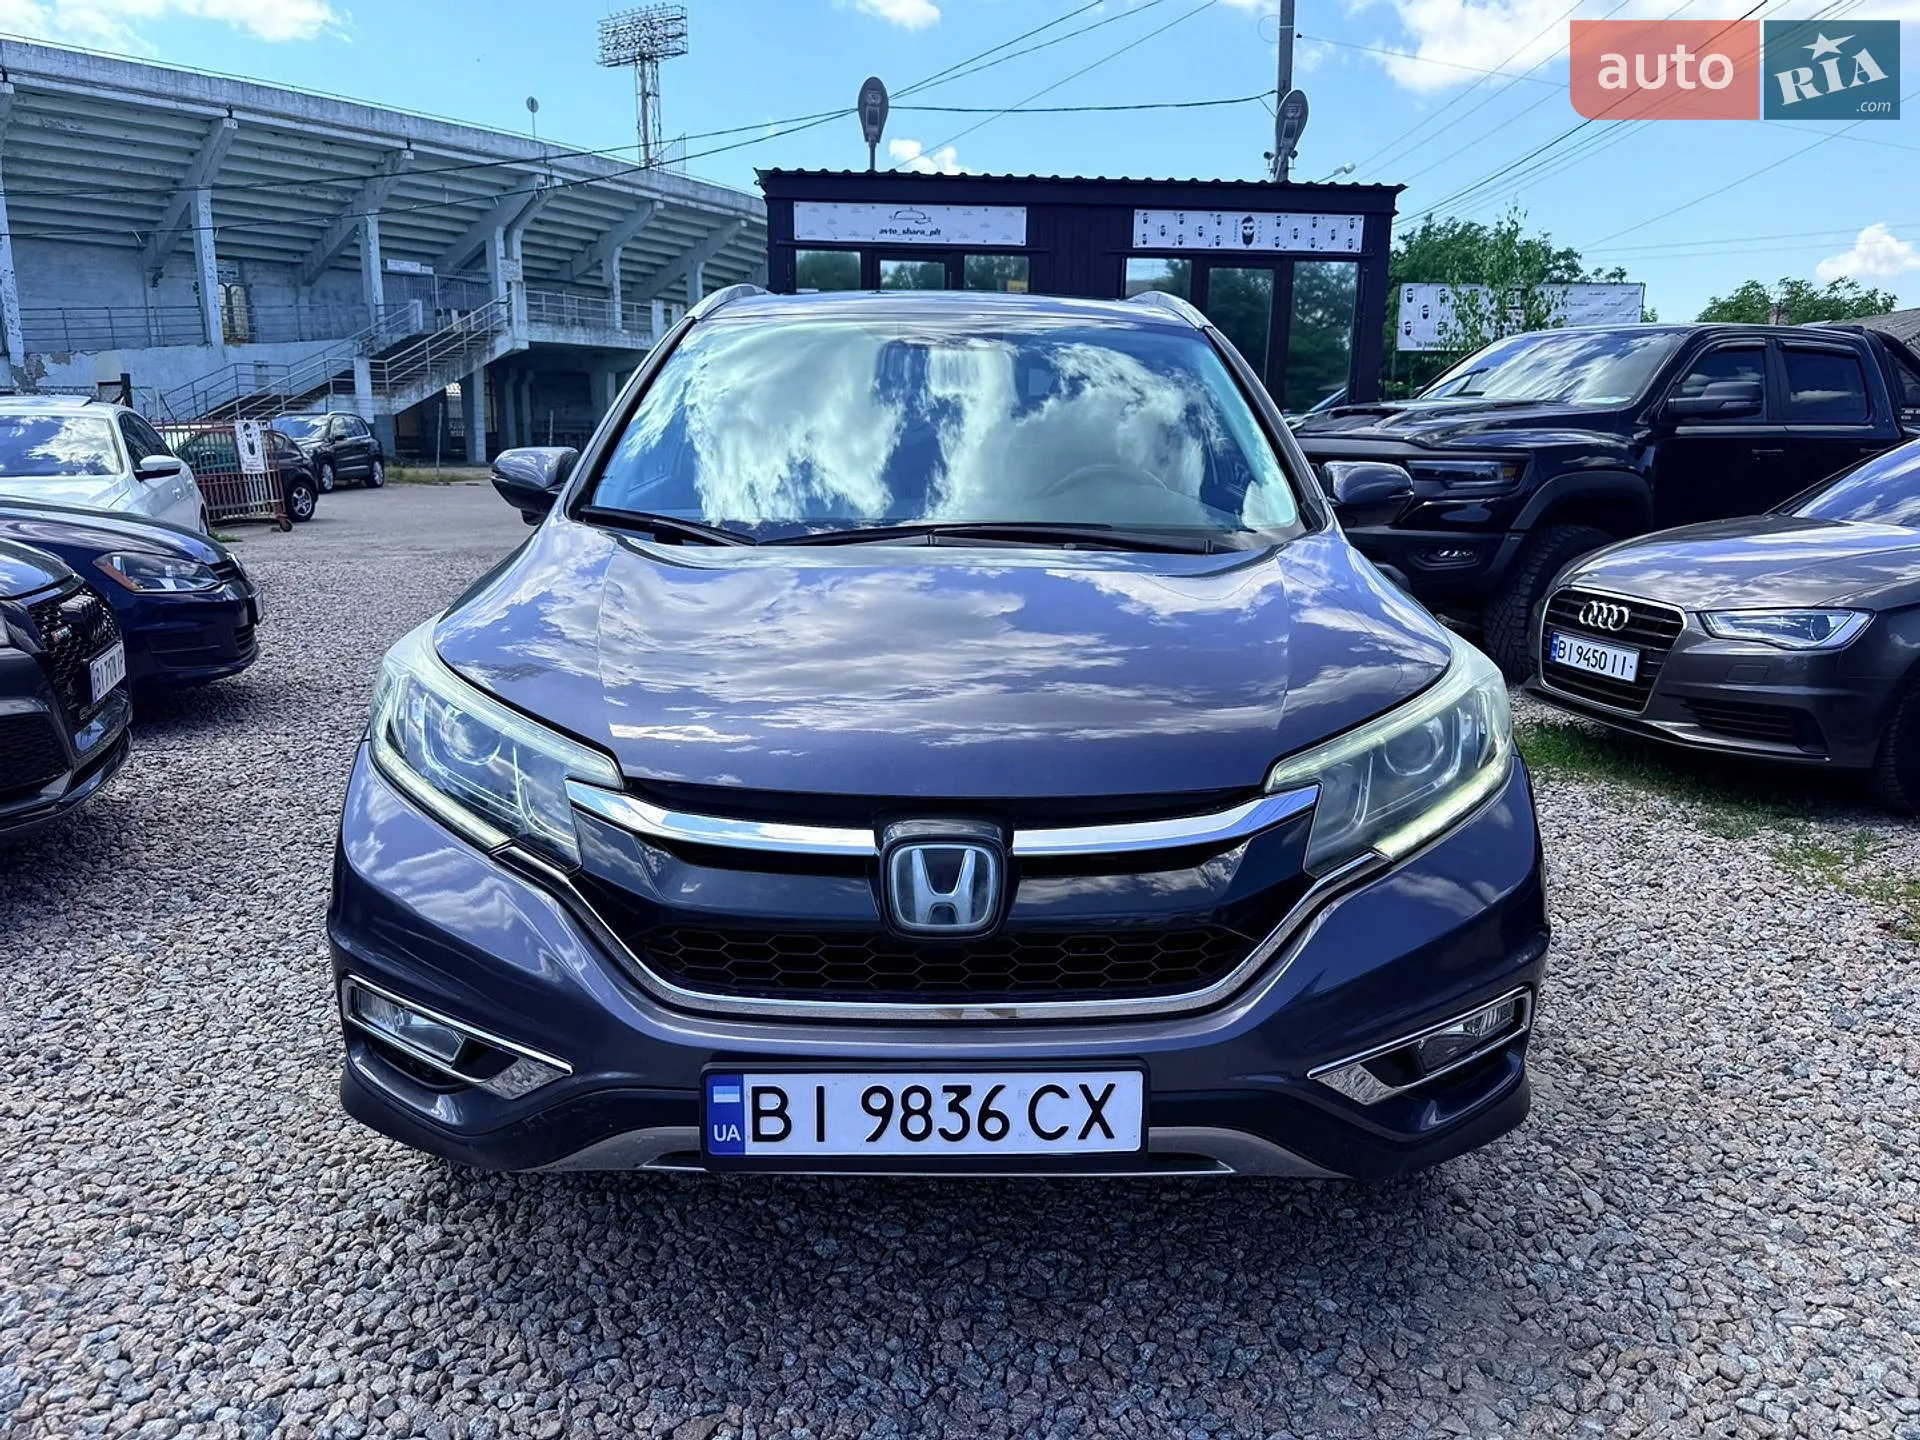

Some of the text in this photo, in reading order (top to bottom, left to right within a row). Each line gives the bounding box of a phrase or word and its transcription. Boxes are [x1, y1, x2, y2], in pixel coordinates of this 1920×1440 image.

[1576, 645, 1608, 671] 9450
[713, 1083, 1116, 1142] UA BI 9836 CX
